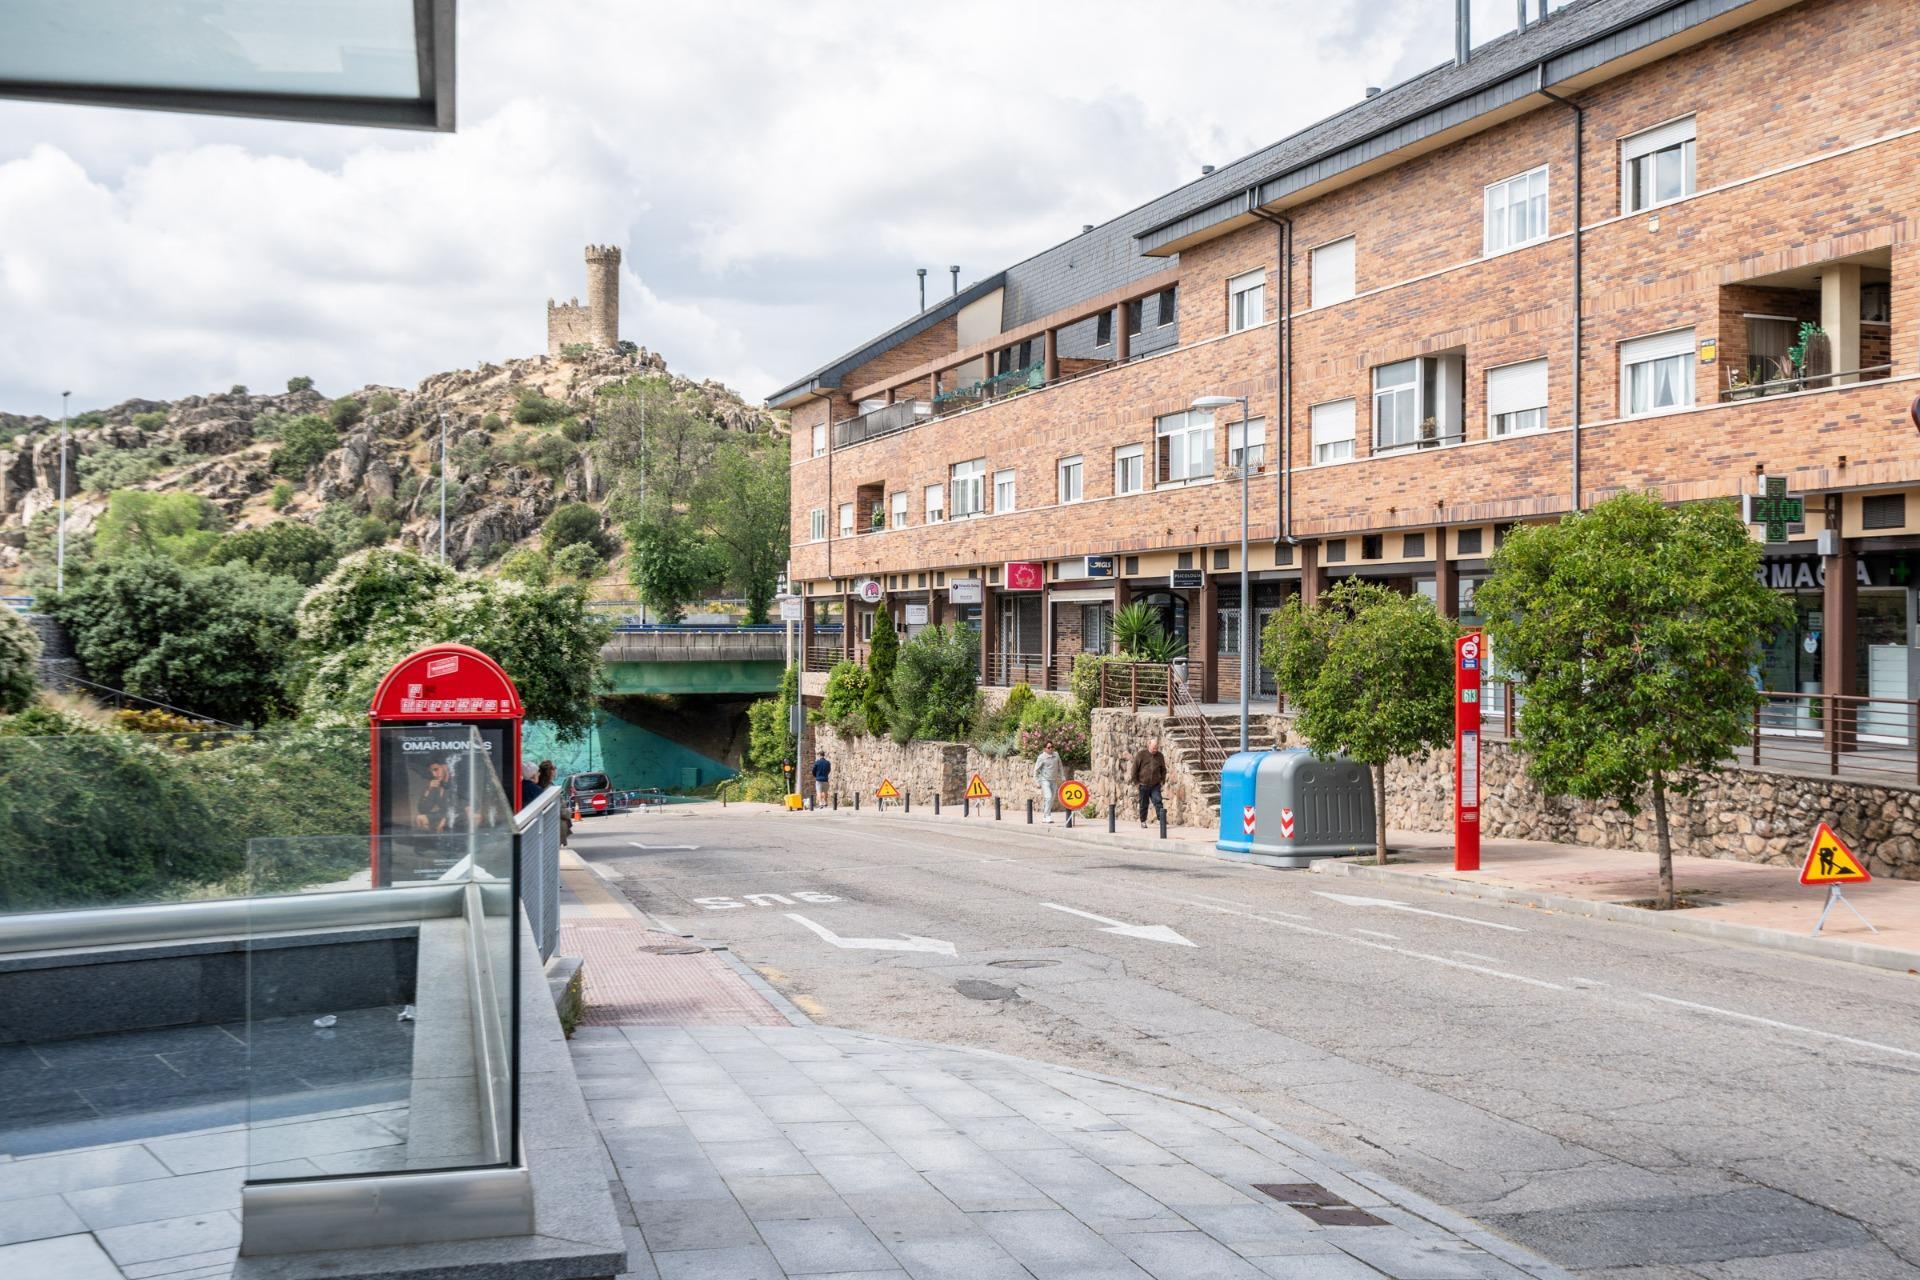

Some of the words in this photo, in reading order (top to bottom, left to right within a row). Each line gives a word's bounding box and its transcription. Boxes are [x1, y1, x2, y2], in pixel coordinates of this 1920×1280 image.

[402, 741, 440, 751] OMAR
[1065, 789, 1082, 800] 20
[693, 891, 842, 910] BUS
